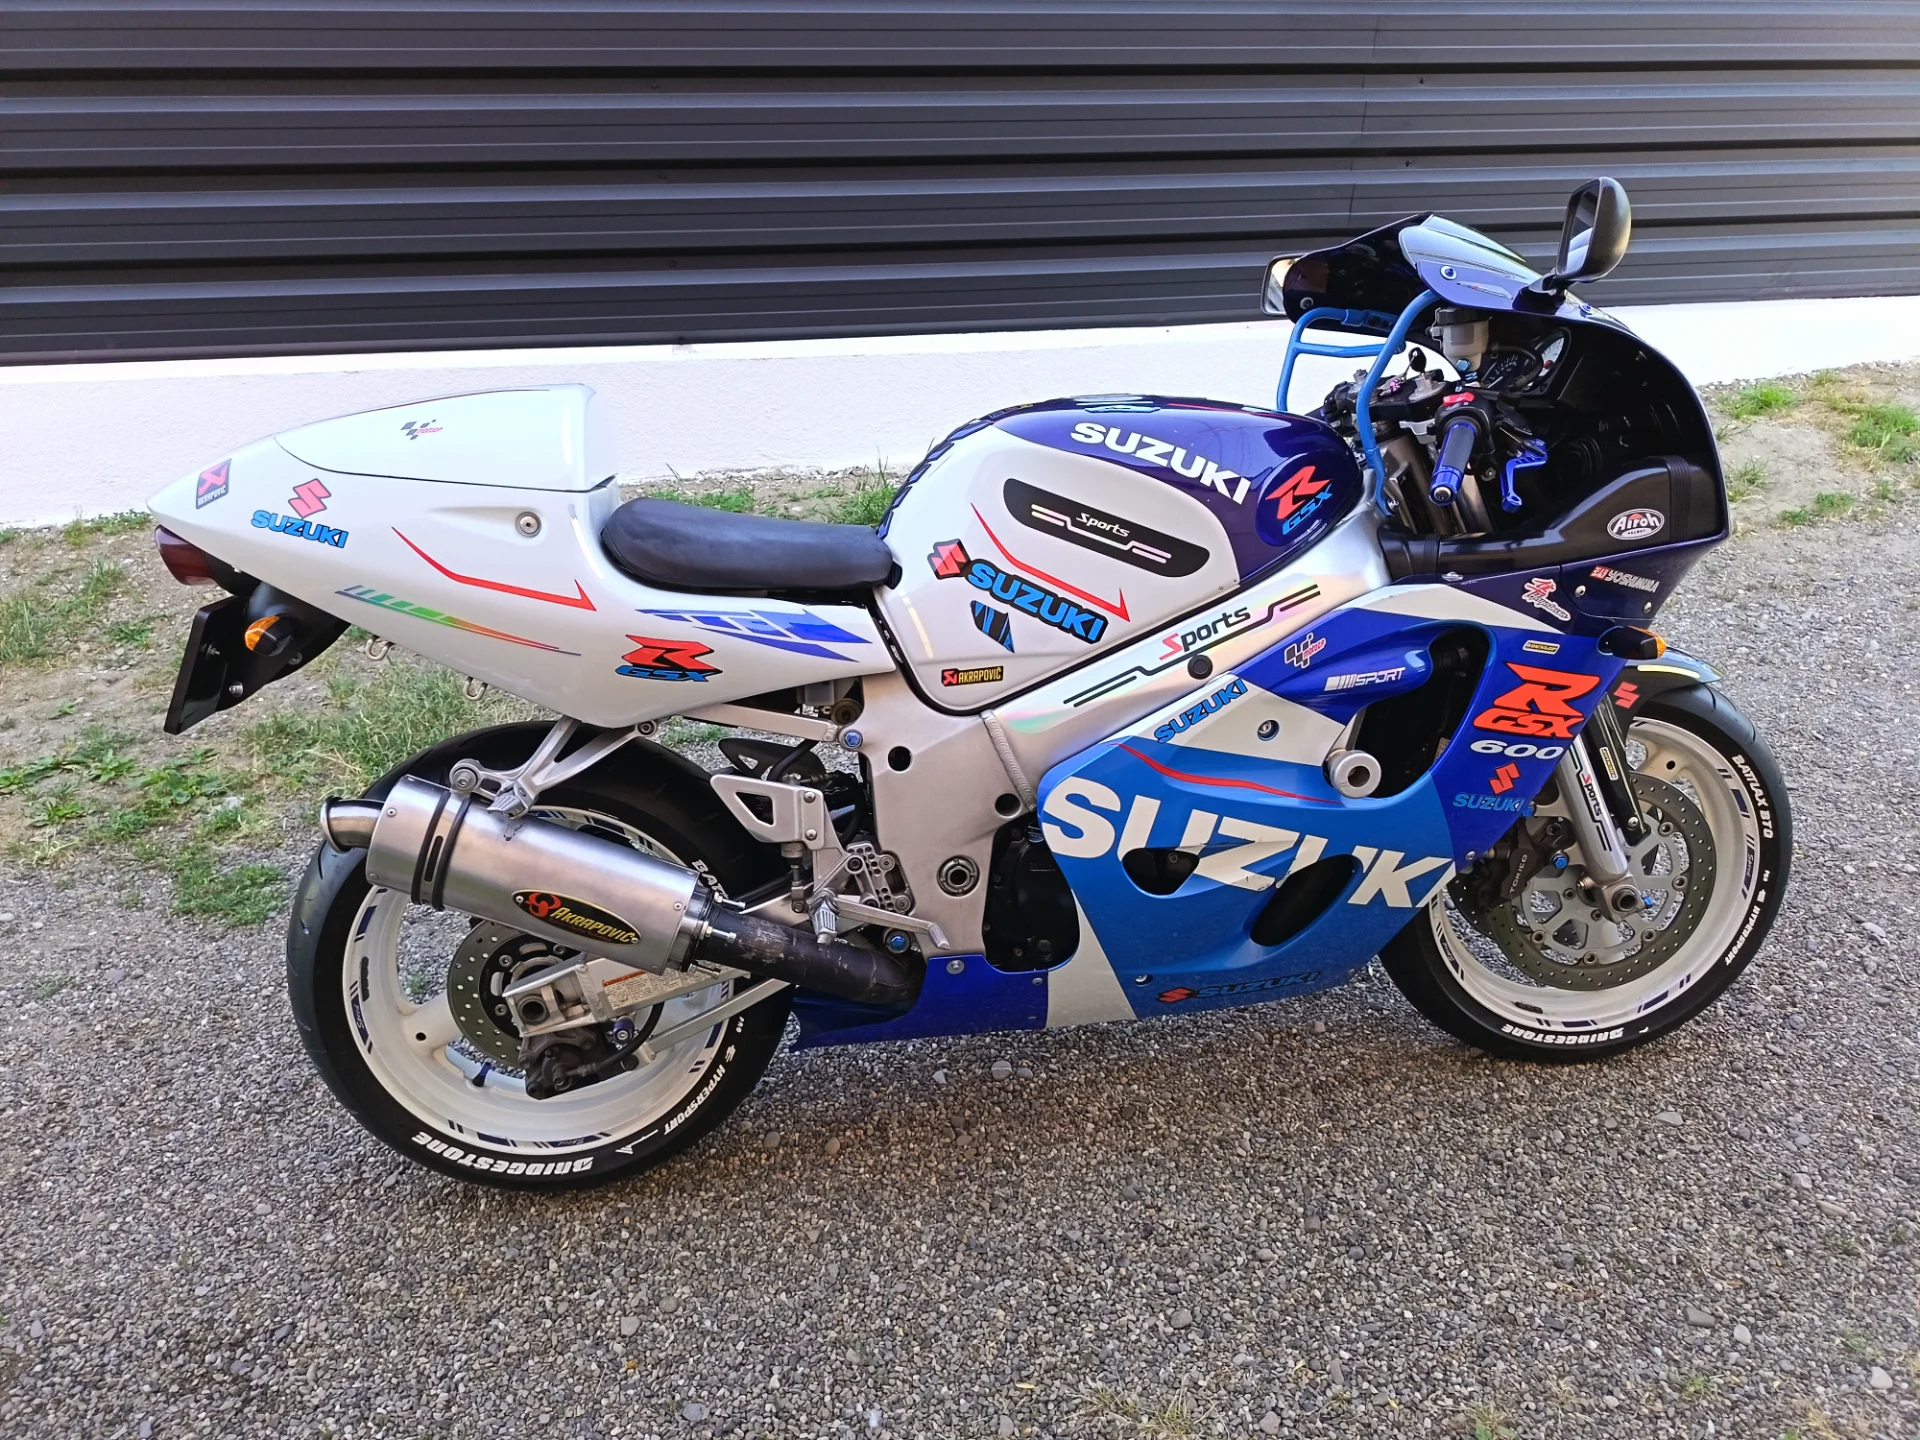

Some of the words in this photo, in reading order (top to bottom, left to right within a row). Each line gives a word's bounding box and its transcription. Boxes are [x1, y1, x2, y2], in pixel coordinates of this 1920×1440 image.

[1070, 422, 1251, 505] SUZUKI
[1265, 465, 1331, 519] R
[1282, 483, 1332, 535] GSX
[251, 510, 349, 548] SUZUKI
[1076, 513, 1130, 537] Sports
[1612, 513, 1660, 535] Airoh
[967, 563, 1104, 642] SUZUKI
[622, 634, 722, 672] R
[1159, 607, 1251, 660] Sports
[615, 665, 713, 682] GSX
[1355, 667, 1406, 686] SPORT
[1493, 662, 1600, 717] R
[1154, 678, 1248, 743] SUZUKI
[1472, 707, 1585, 738] GSX
[1470, 739, 1564, 760] 600
[1582, 773, 1602, 816] Sports
[1732, 754, 1769, 807] BATTLAX
[1453, 793, 1526, 812] SUZUKI
[1509, 854, 1528, 894] TOKICO
[1197, 970, 1322, 998] SUZUKI
[1501, 1023, 1625, 1045] BRIDGESTONE
[664, 1064, 726, 1136] HYPERSPORT
[411, 1131, 594, 1176] BRIDGESTONE
